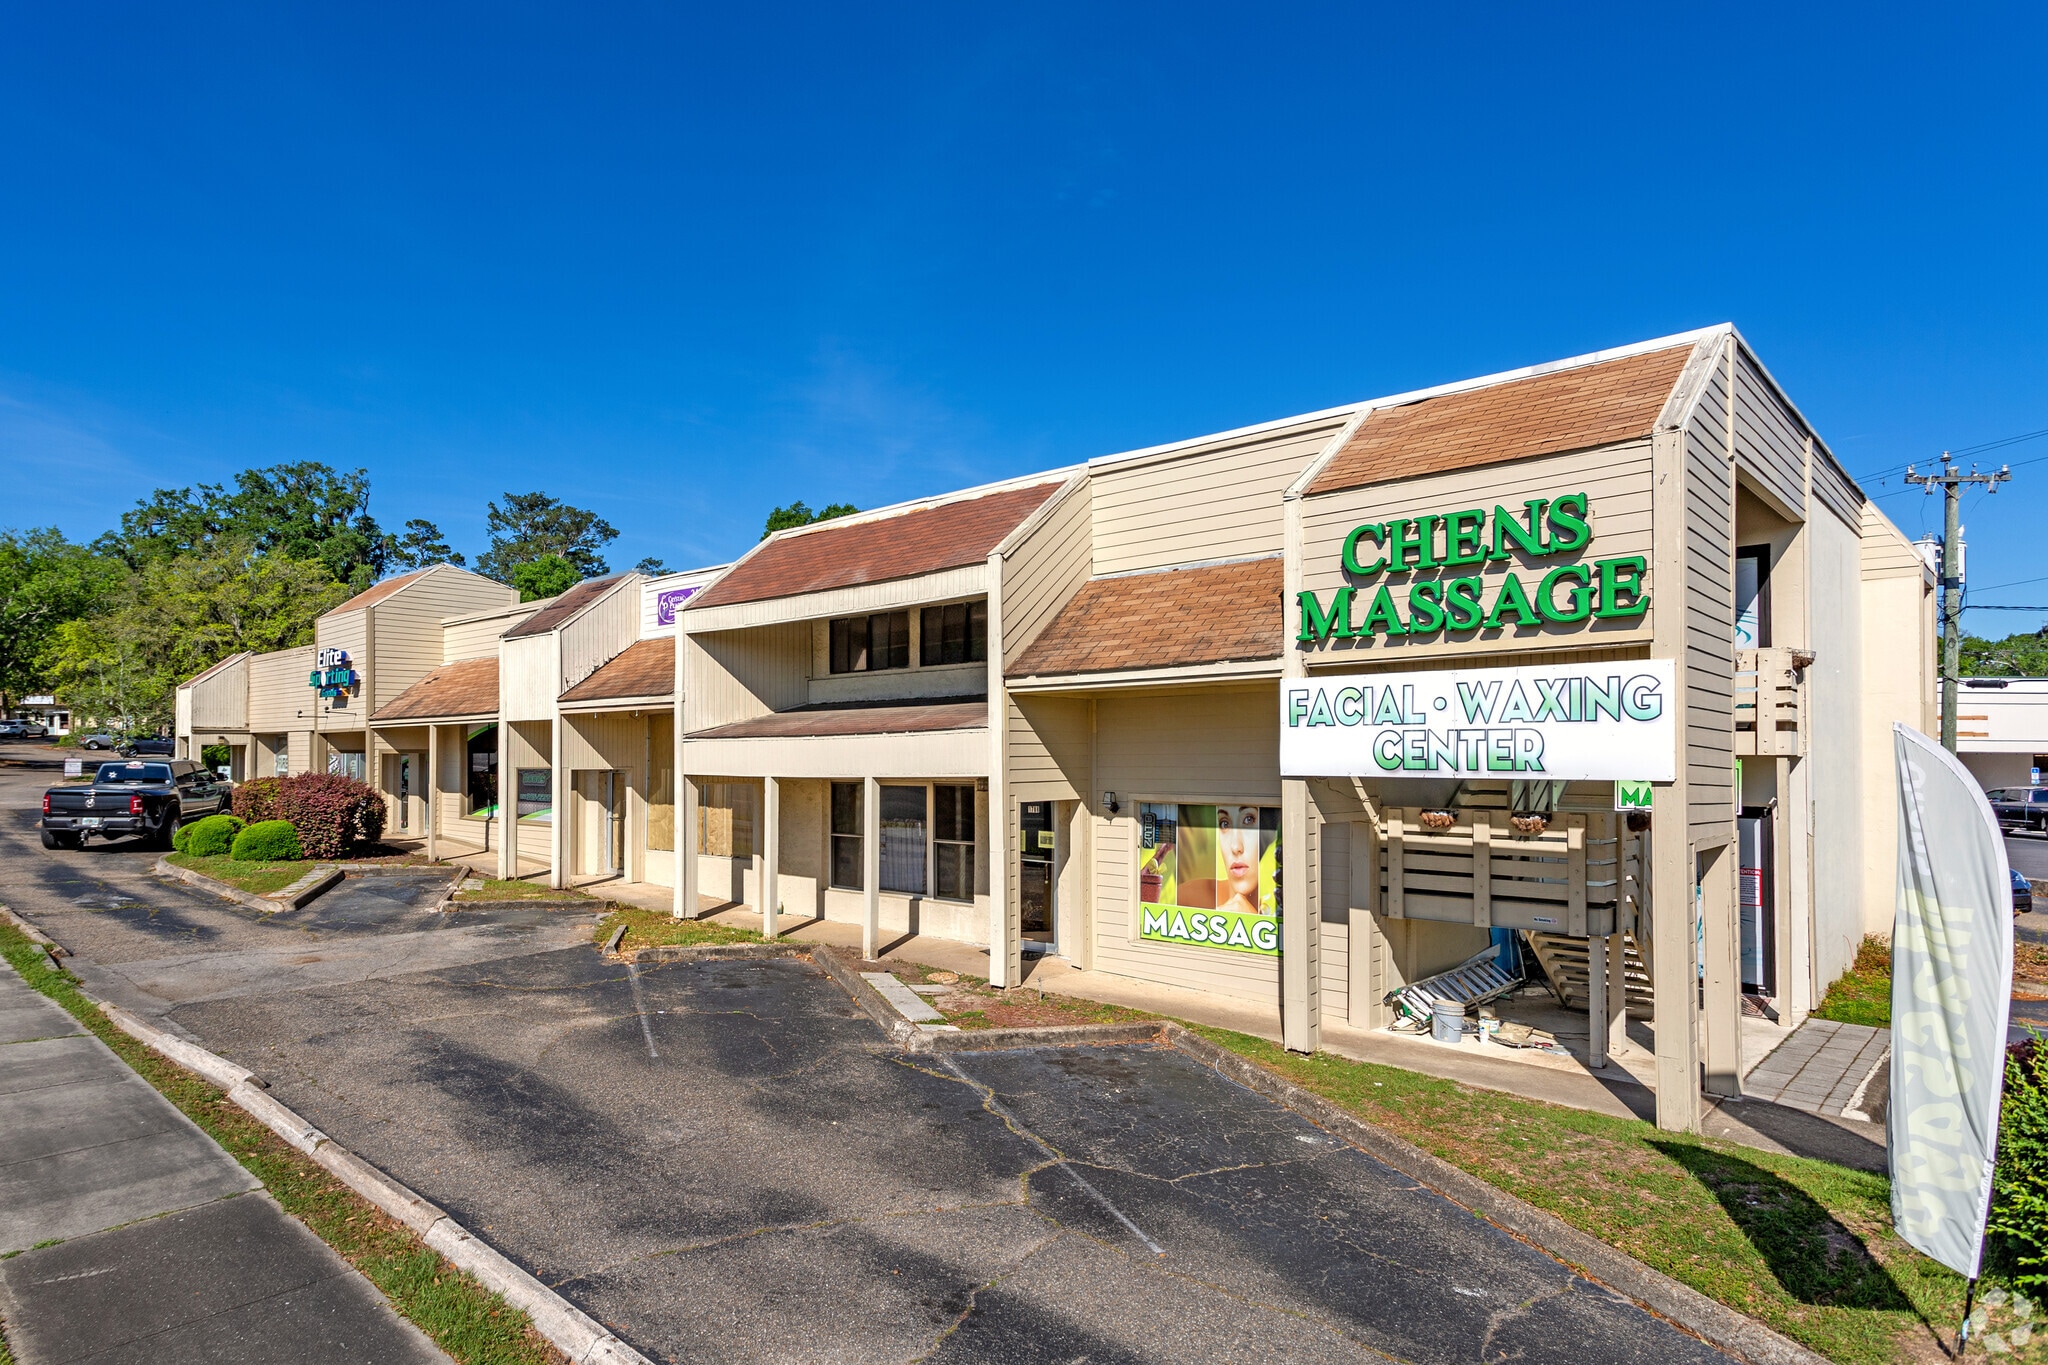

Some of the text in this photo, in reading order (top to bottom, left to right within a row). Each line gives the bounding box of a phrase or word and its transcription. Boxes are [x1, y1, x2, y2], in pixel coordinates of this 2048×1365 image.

[1341, 491, 1592, 577] CHENS
[1296, 555, 1650, 642] MASSAGE
[309, 669, 350, 688] Sporting
[318, 649, 342, 668] Elite
[1288, 674, 1663, 727] FACIAL WAXING
[1373, 728, 1546, 772] CENTER
